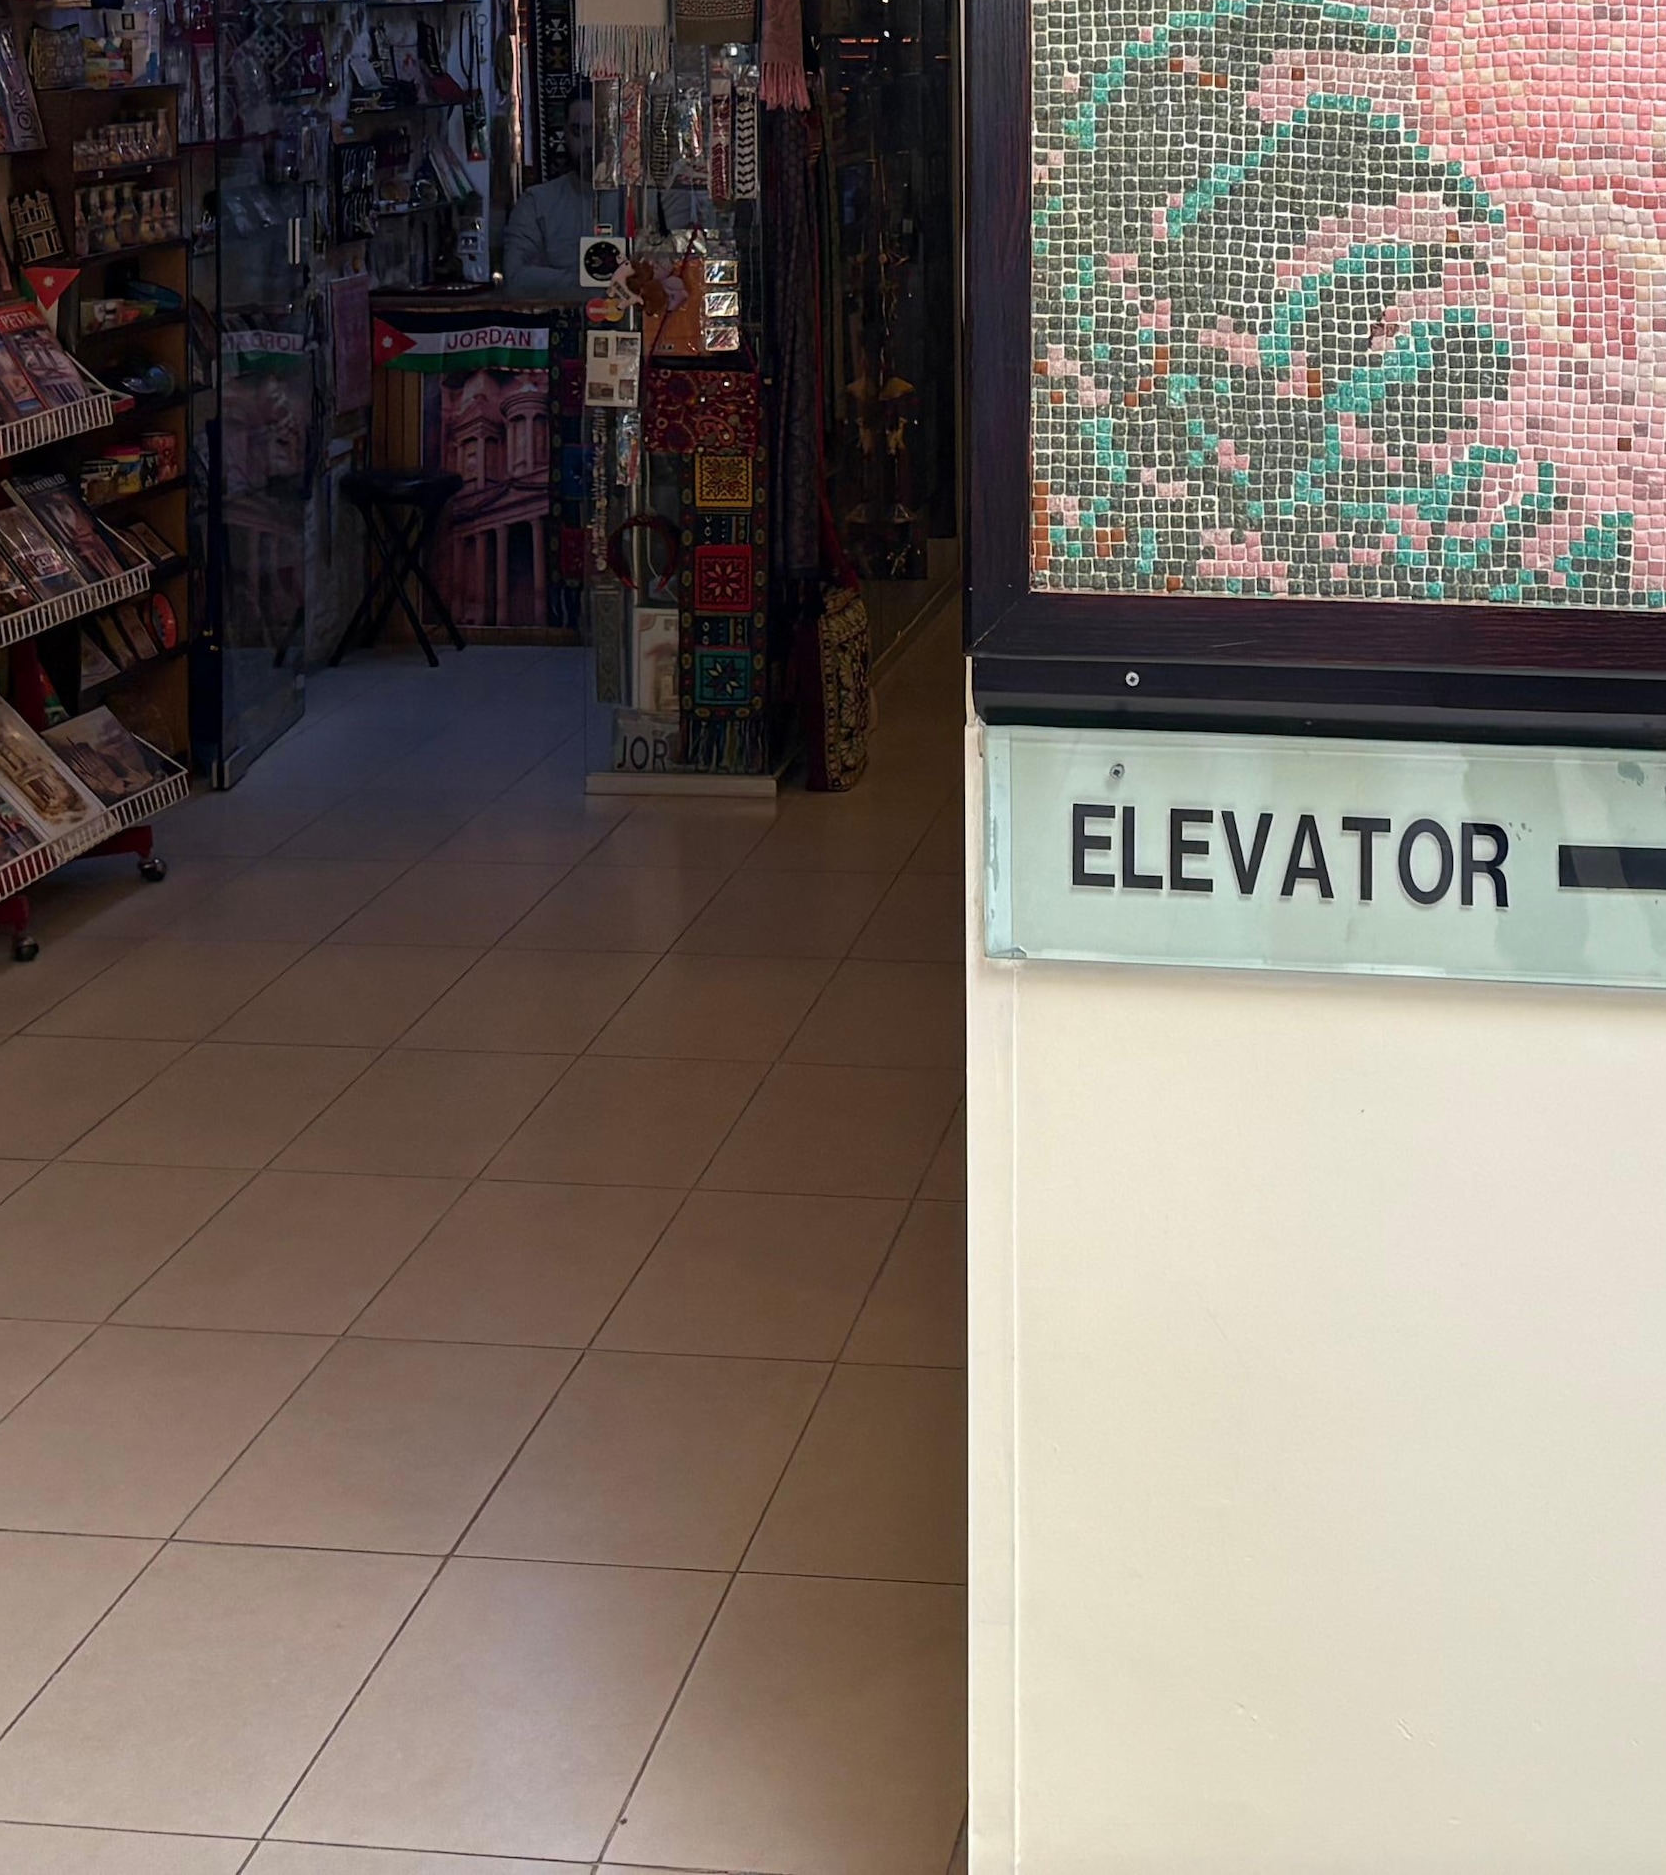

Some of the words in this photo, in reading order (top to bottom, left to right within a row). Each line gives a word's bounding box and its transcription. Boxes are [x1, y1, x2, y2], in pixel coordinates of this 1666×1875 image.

[0, 310, 39, 330] PETRA
[447, 330, 531, 350] JORDAN
[616, 736, 669, 773] JOR
[1070, 802, 1509, 910] ELEVATOR
